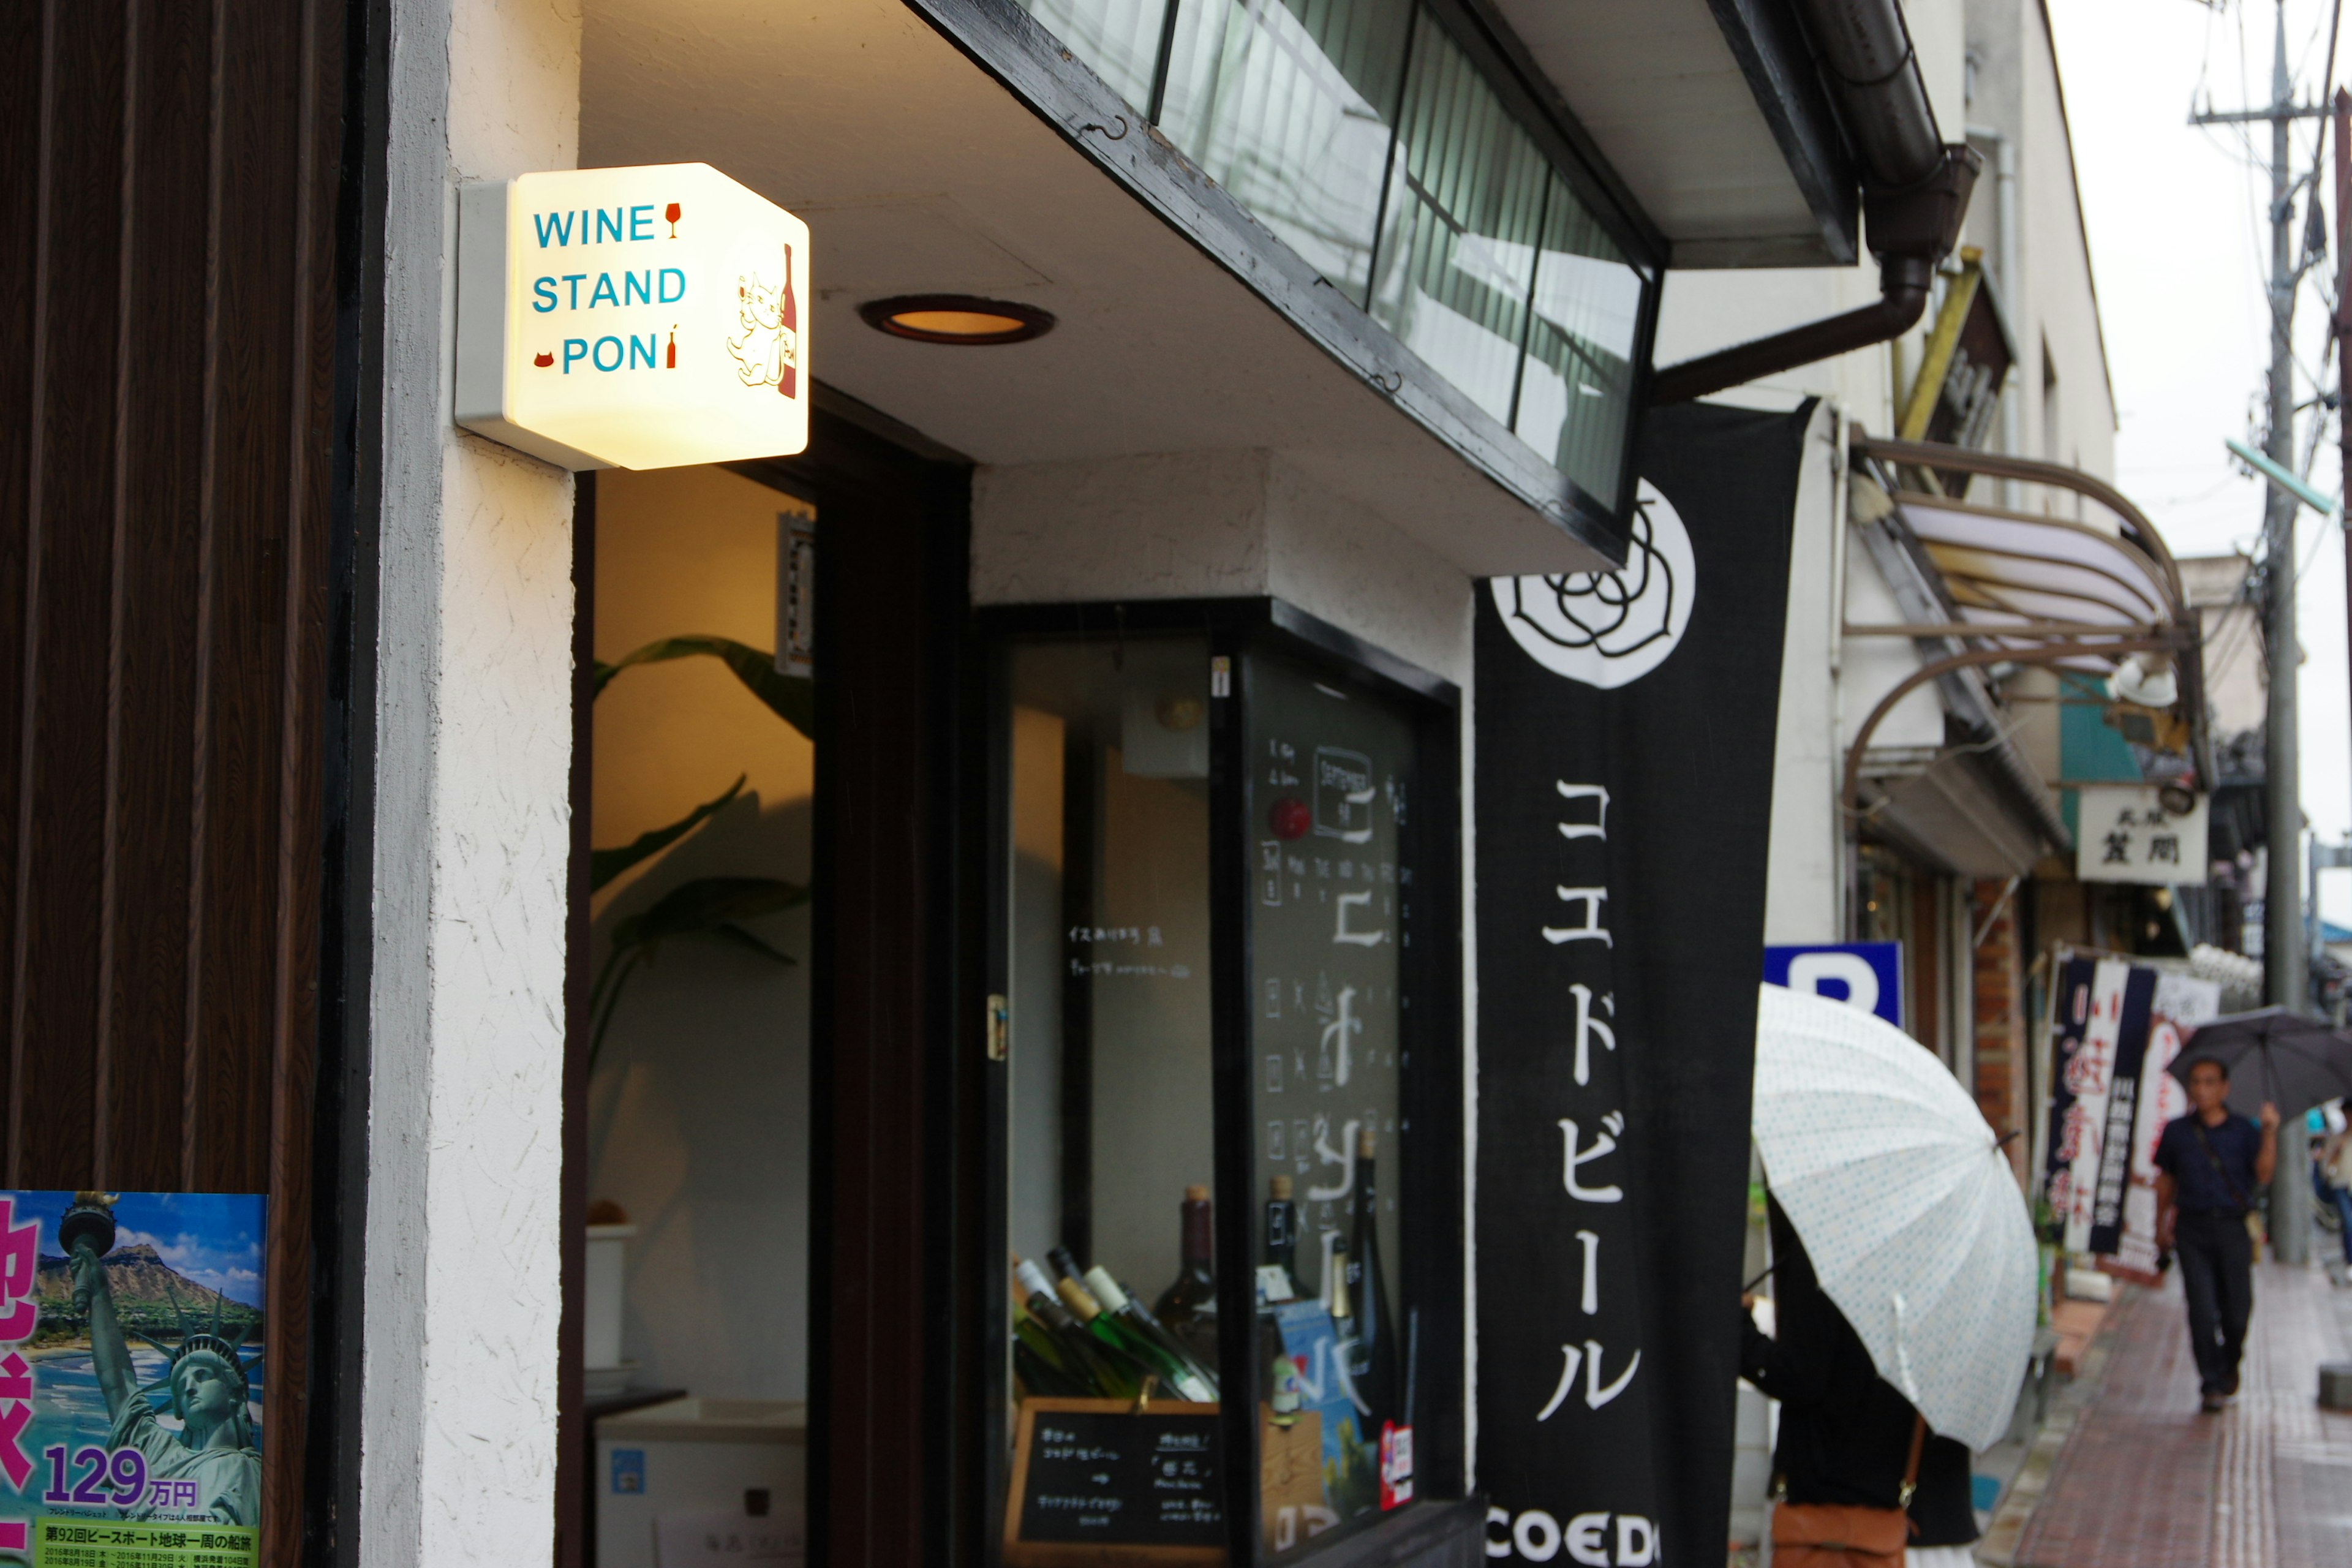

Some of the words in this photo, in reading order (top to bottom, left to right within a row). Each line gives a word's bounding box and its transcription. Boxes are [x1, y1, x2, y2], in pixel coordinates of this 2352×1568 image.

[533, 204, 655, 249] WINE
[532, 267, 686, 314] STAND
[562, 333, 657, 375] PON
[1537, 778, 1642, 1422] コエドビール
[45, 1526, 251, 1551] 第92回ピースボート地球一周の船旅
[1485, 1504, 1662, 1568] COED
